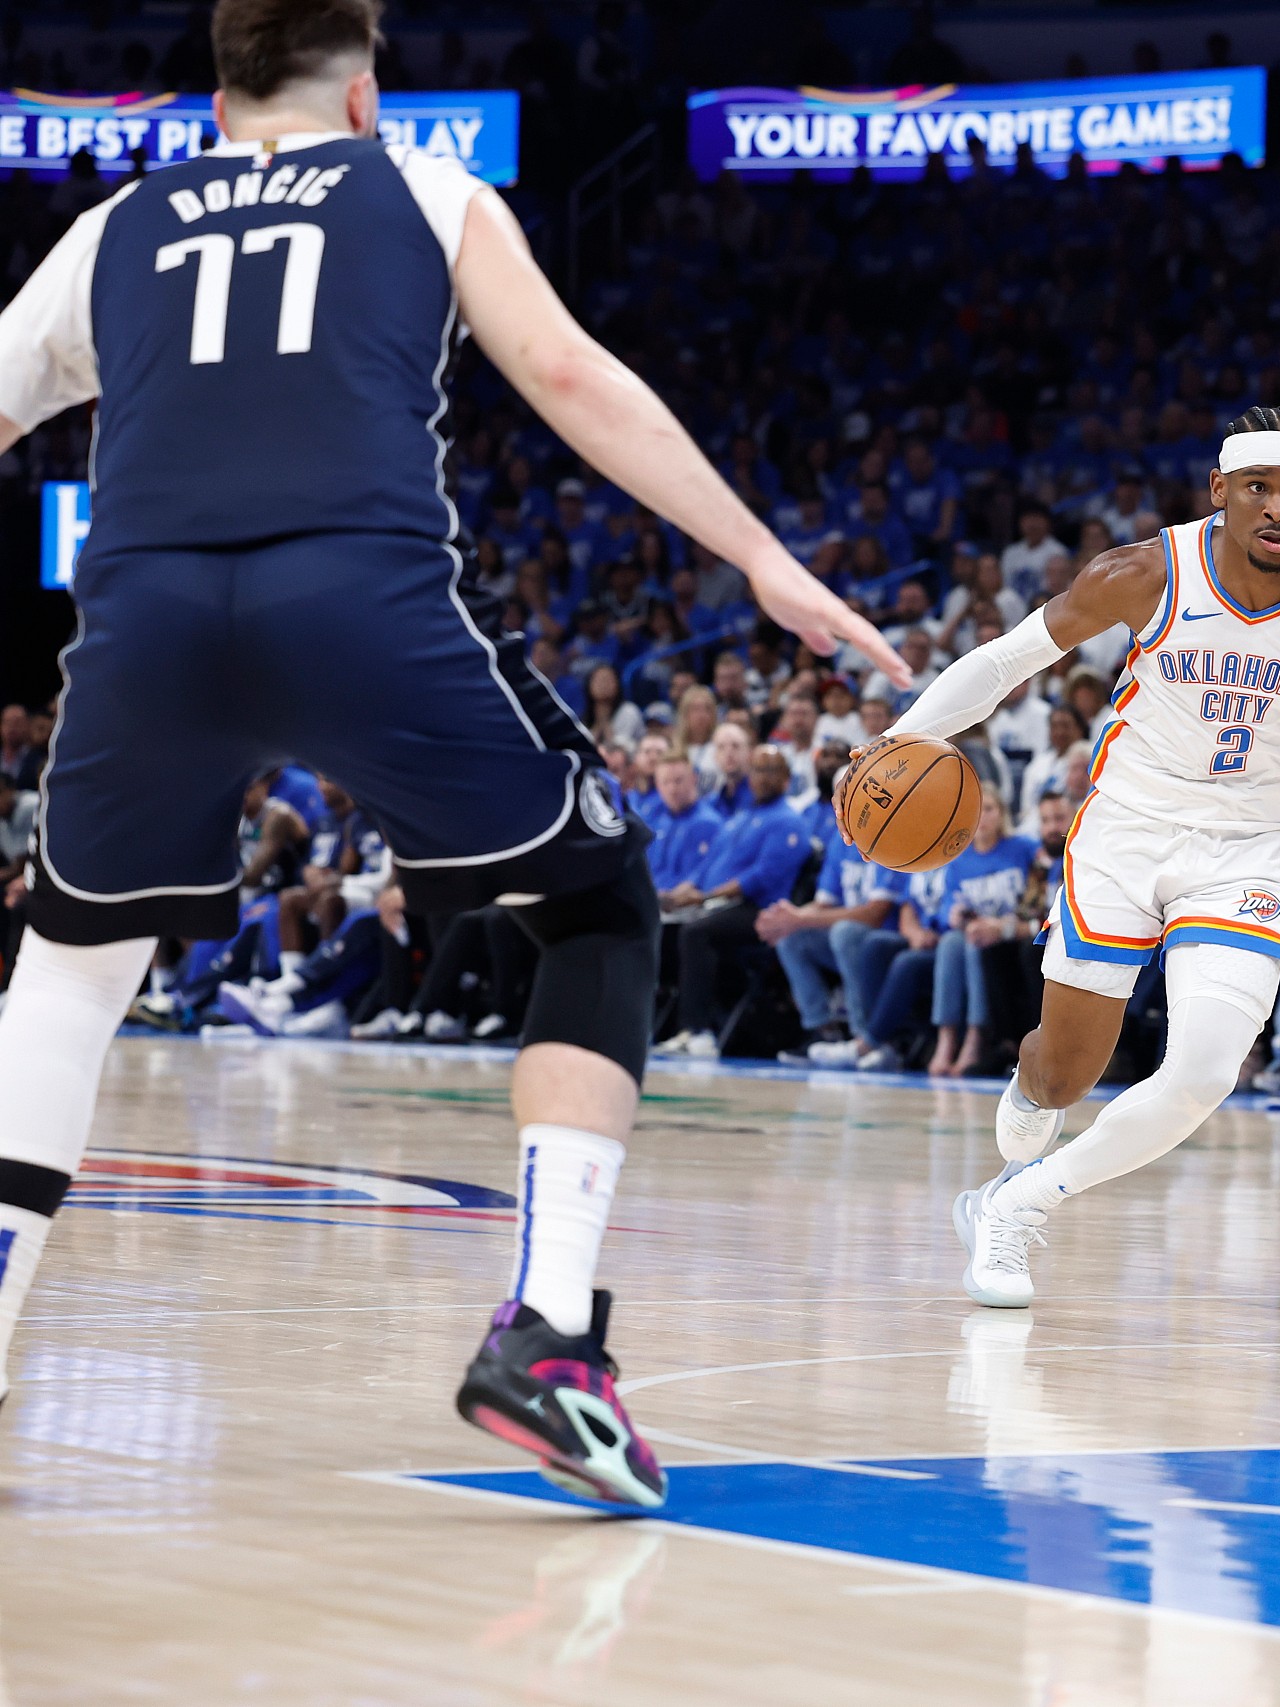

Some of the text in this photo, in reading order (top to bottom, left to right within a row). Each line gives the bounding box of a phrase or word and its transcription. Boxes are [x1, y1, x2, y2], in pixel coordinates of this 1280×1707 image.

[37, 116, 151, 161] BEST
[727, 98, 1232, 158] YOUR FAVORITE GAMES!
[155, 222, 325, 365] 77
[1200, 690, 1274, 723] CITY
[1209, 725, 1255, 775] 2
[1239, 897, 1276, 912] OKC
